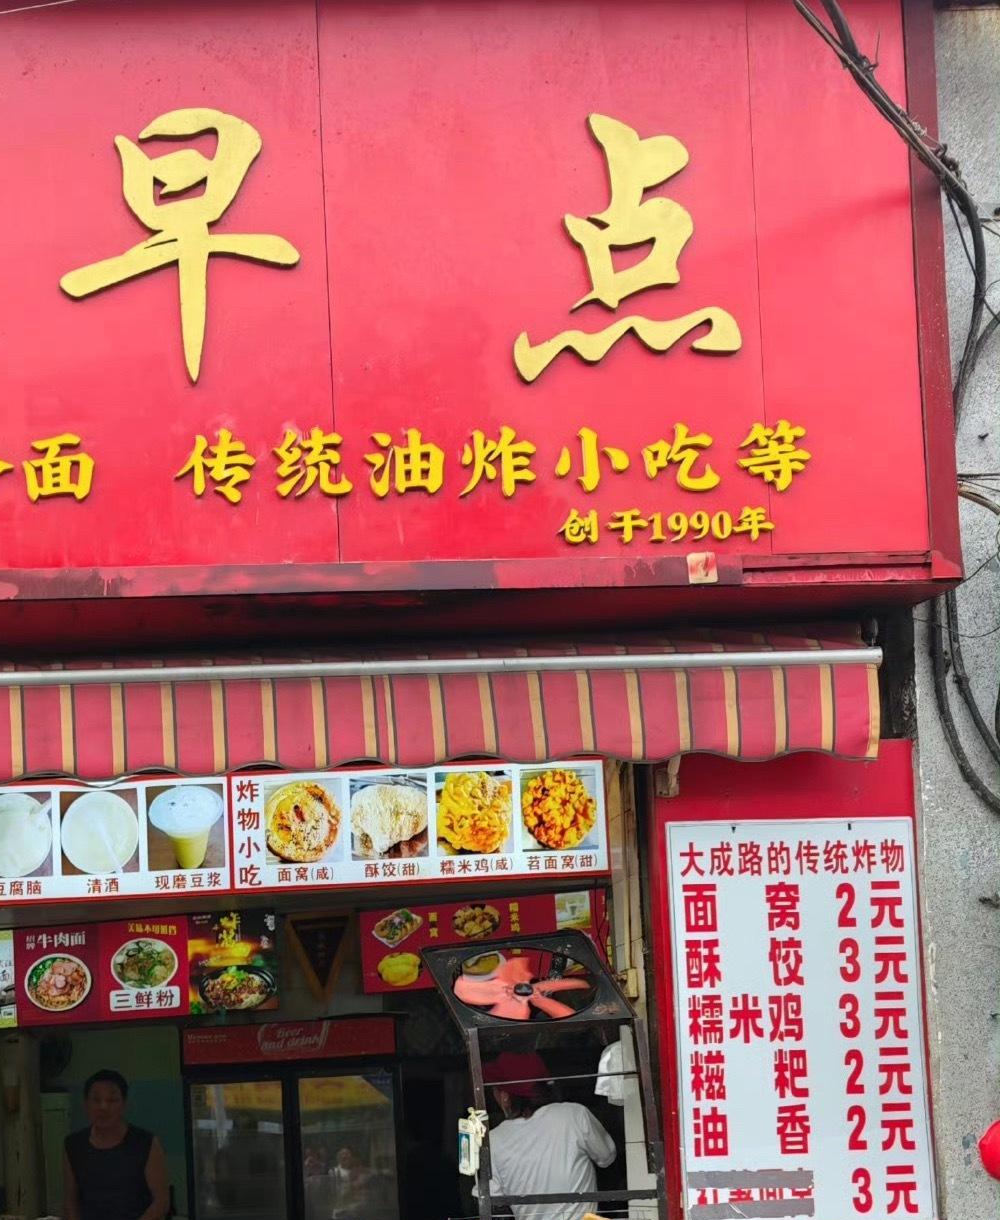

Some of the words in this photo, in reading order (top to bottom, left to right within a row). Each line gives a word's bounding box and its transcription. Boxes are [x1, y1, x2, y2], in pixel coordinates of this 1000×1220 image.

[175, 420, 812, 506] 传统油炸小吃等
[557, 506, 775, 546] 创于1990年
[236, 780, 262, 887] 炸物小吃
[679, 839, 905, 877] 大成路的传统炸物
[86, 878, 120, 894] 清酒
[154, 872, 222, 890] 现磨豆浆
[682, 881, 800, 933] 面窝
[836, 880, 905, 930] 2元
[685, 938, 805, 989] 酥饺
[839, 936, 909, 985] 3元
[114, 988, 174, 1010] 三鲜粉
[688, 993, 804, 1045] 糯米鸡
[839, 991, 908, 1040] 3元
[690, 1049, 809, 1101] 糍粑
[843, 1046, 913, 1096] 2元
[693, 1104, 811, 1157] 油香
[847, 1102, 916, 1152] 2元
[851, 1164, 919, 1215] 3元
